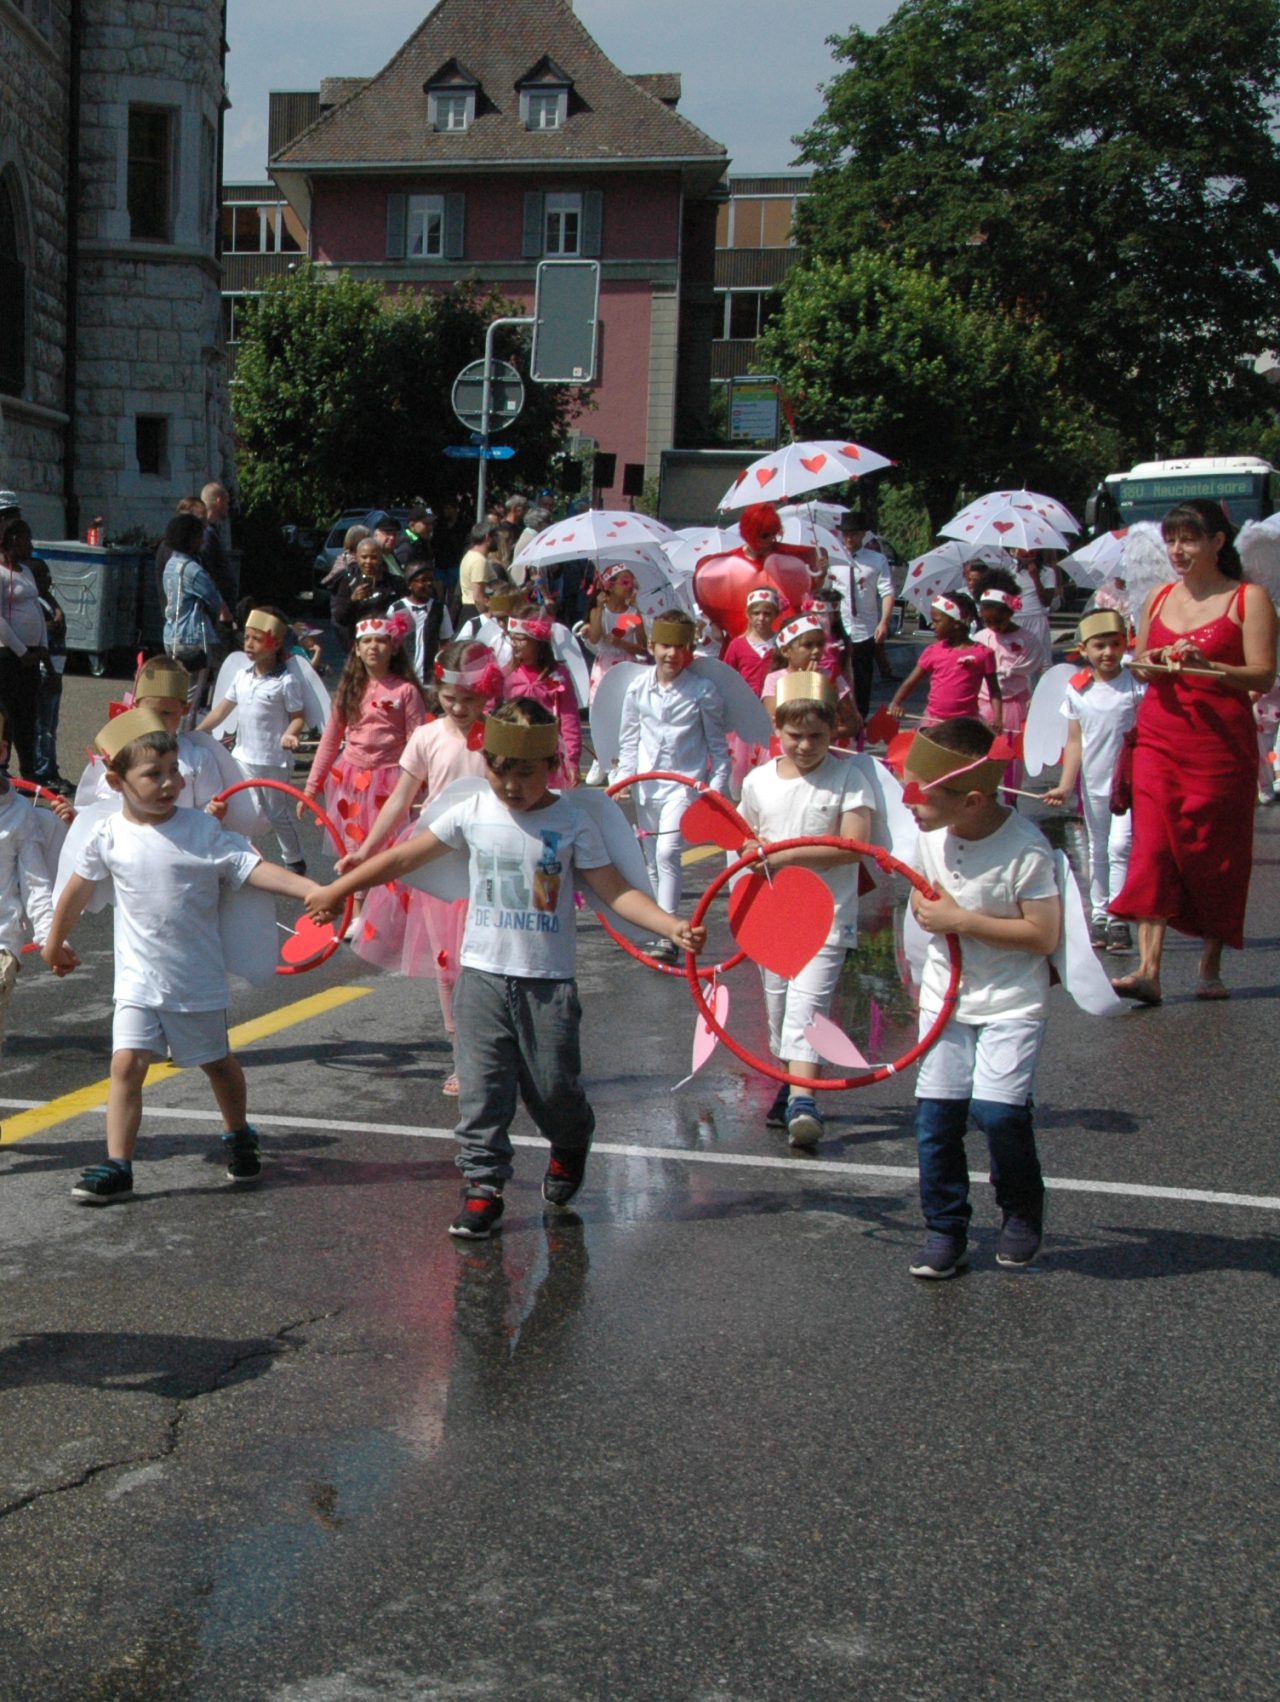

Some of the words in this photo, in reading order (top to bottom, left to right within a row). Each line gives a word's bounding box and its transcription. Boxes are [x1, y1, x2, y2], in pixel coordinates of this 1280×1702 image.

[1217, 482, 1247, 495] gare
[475, 908, 490, 927] DE
[493, 910, 560, 933] JANEIRO
